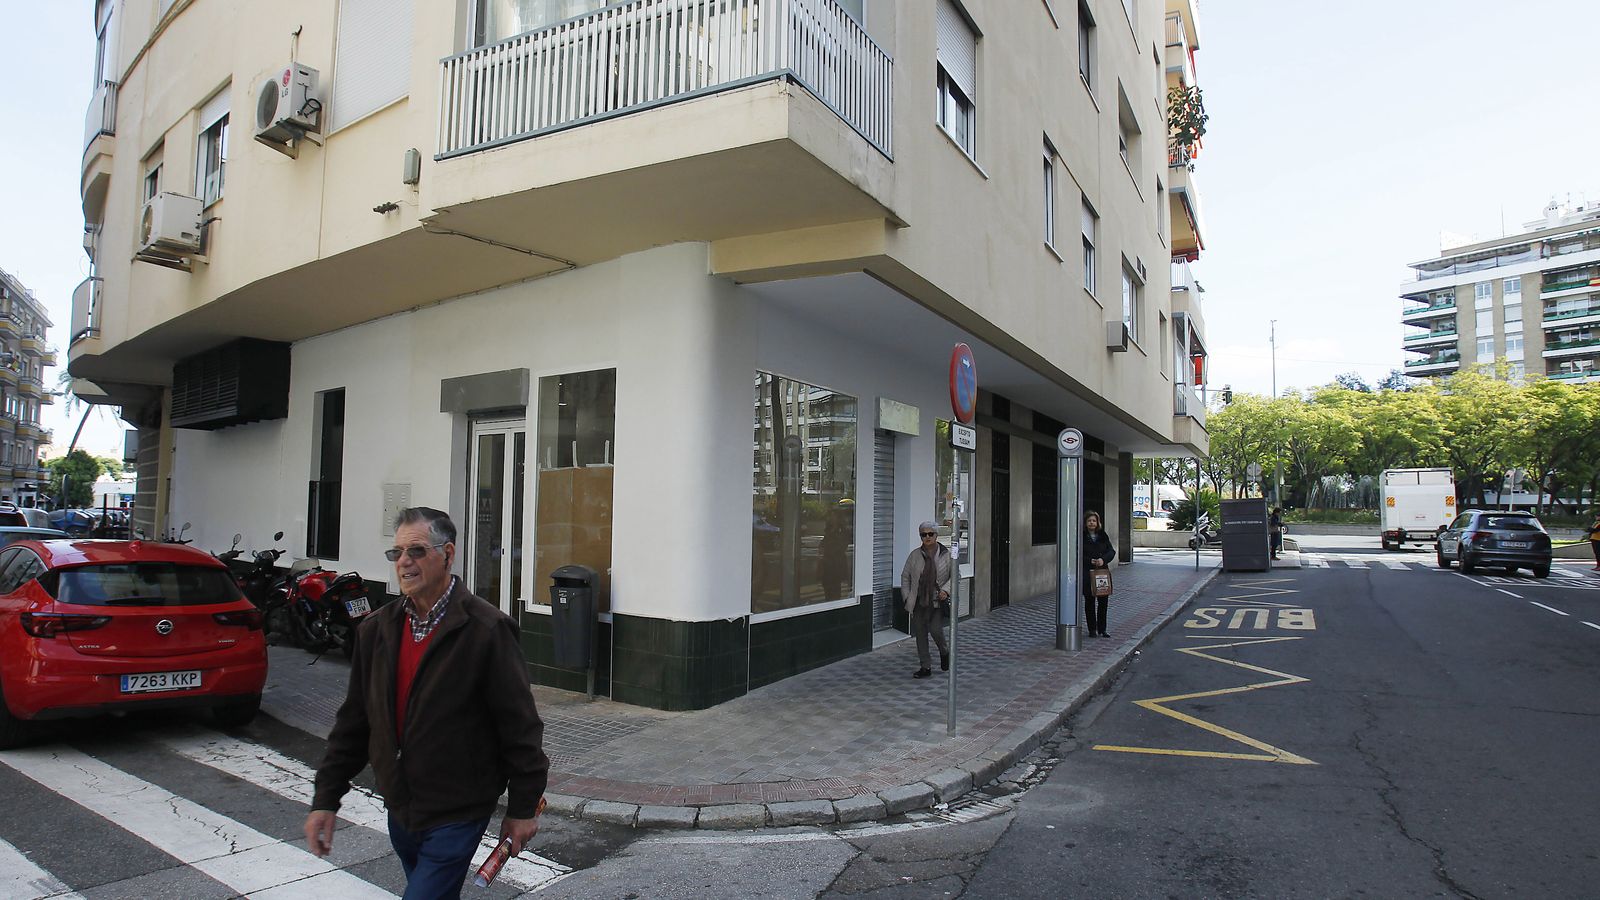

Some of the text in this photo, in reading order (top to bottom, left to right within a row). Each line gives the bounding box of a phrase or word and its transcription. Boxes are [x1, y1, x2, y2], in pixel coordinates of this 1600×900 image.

[281, 87, 289, 98] LG
[1134, 496, 1150, 505] rgo
[1183, 608, 1317, 631] BUS
[130, 673, 197, 689] 7263 KKP
